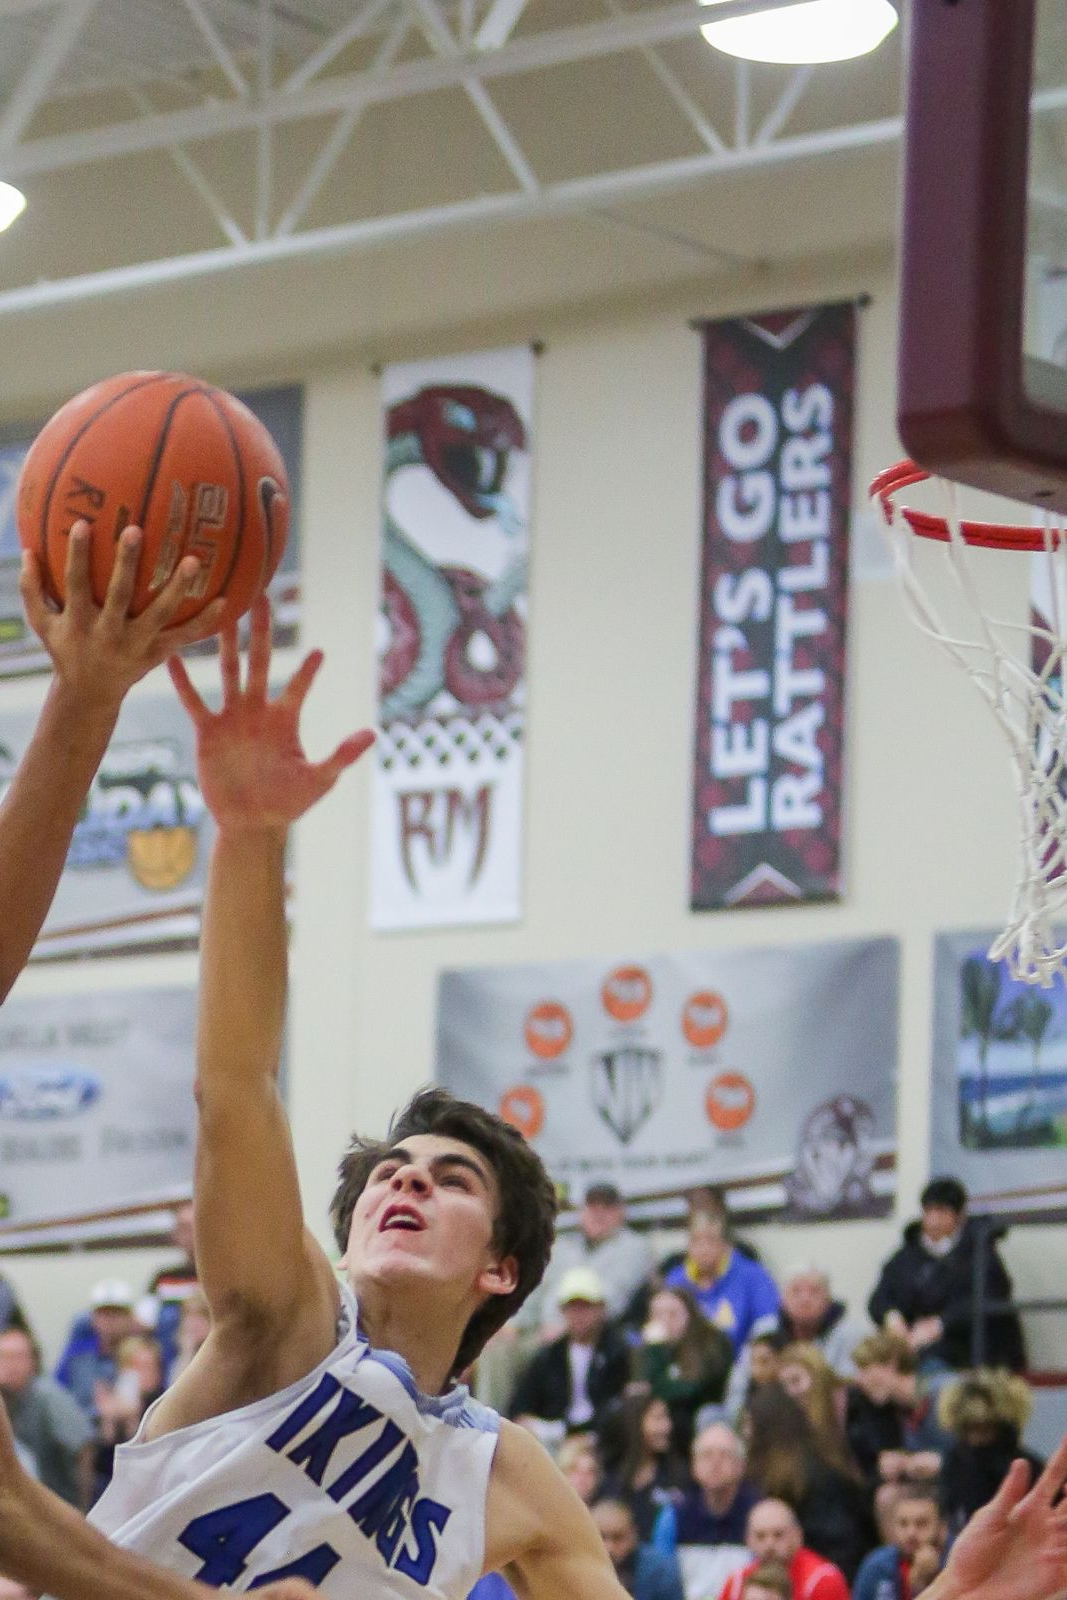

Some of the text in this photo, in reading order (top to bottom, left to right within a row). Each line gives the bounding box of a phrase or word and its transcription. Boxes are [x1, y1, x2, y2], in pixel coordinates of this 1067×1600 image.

[708, 391, 779, 837] LET'S GO
[770, 381, 834, 832] RATTLERS
[397, 782, 495, 896] RM
[265, 1371, 452, 1587] IKINGS
